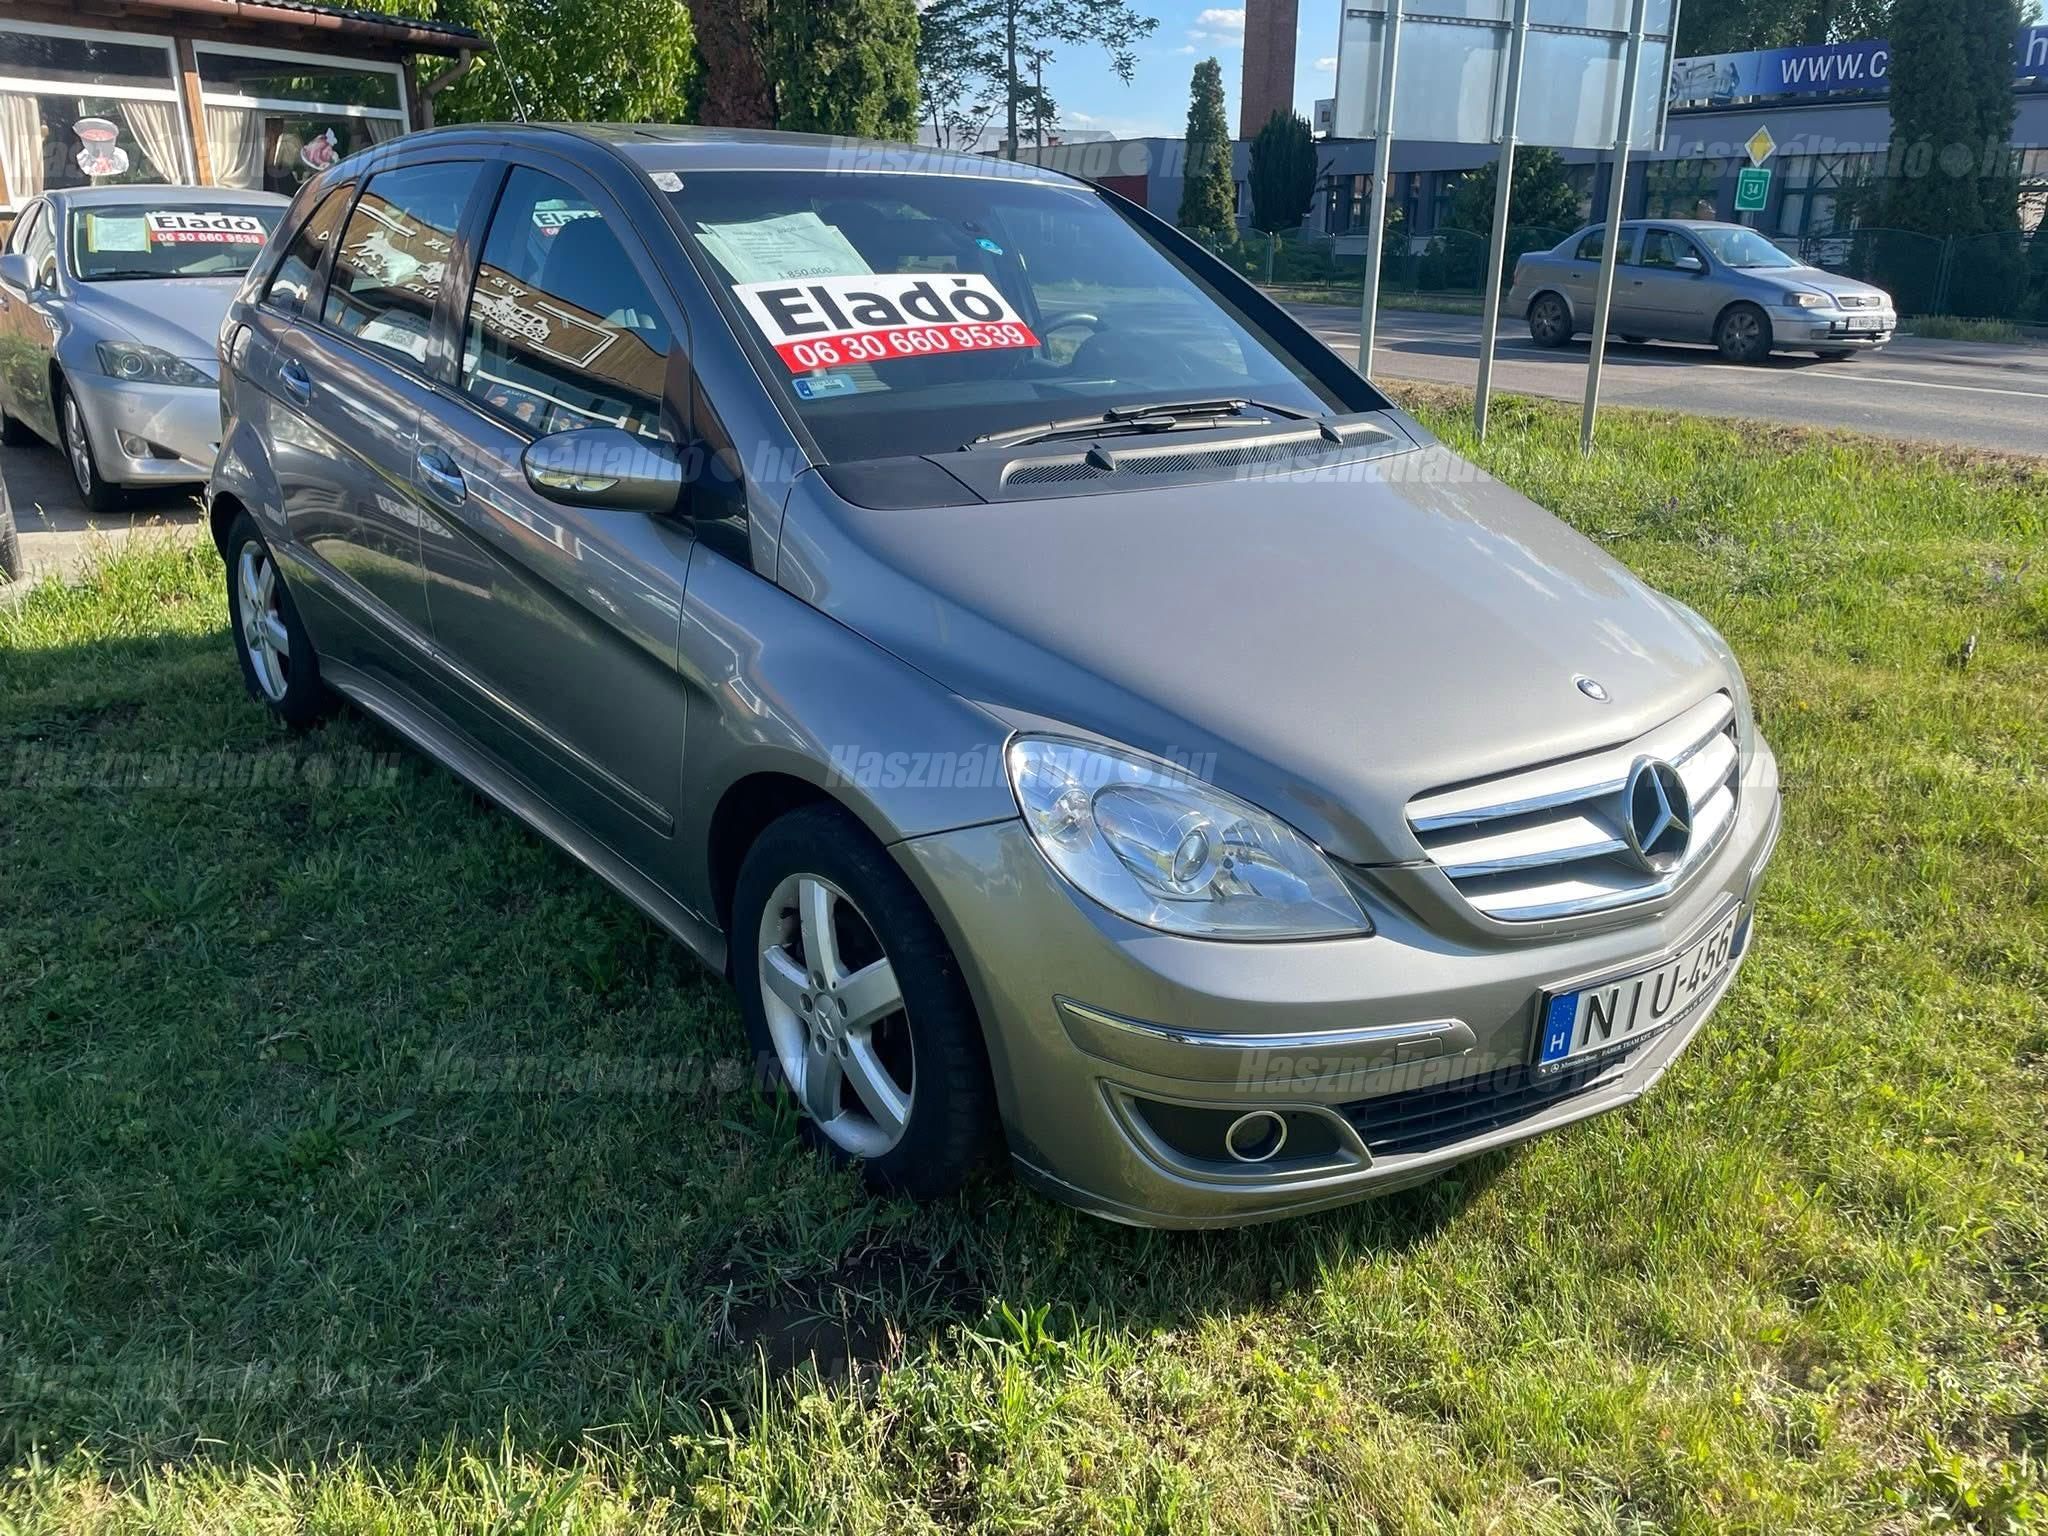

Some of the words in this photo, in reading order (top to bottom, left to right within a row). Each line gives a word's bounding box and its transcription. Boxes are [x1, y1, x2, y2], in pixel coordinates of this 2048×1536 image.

[1781, 51, 1888, 84] www.c
[154, 216, 257, 231] Eladó
[755, 278, 1004, 336] Eladó
[792, 341, 840, 367] 06
[848, 334, 886, 360] 30
[888, 328, 950, 354] 660
[949, 324, 1026, 348] 9539
[1580, 919, 1734, 1047] NIU-456
[1550, 1032, 1566, 1053] H
